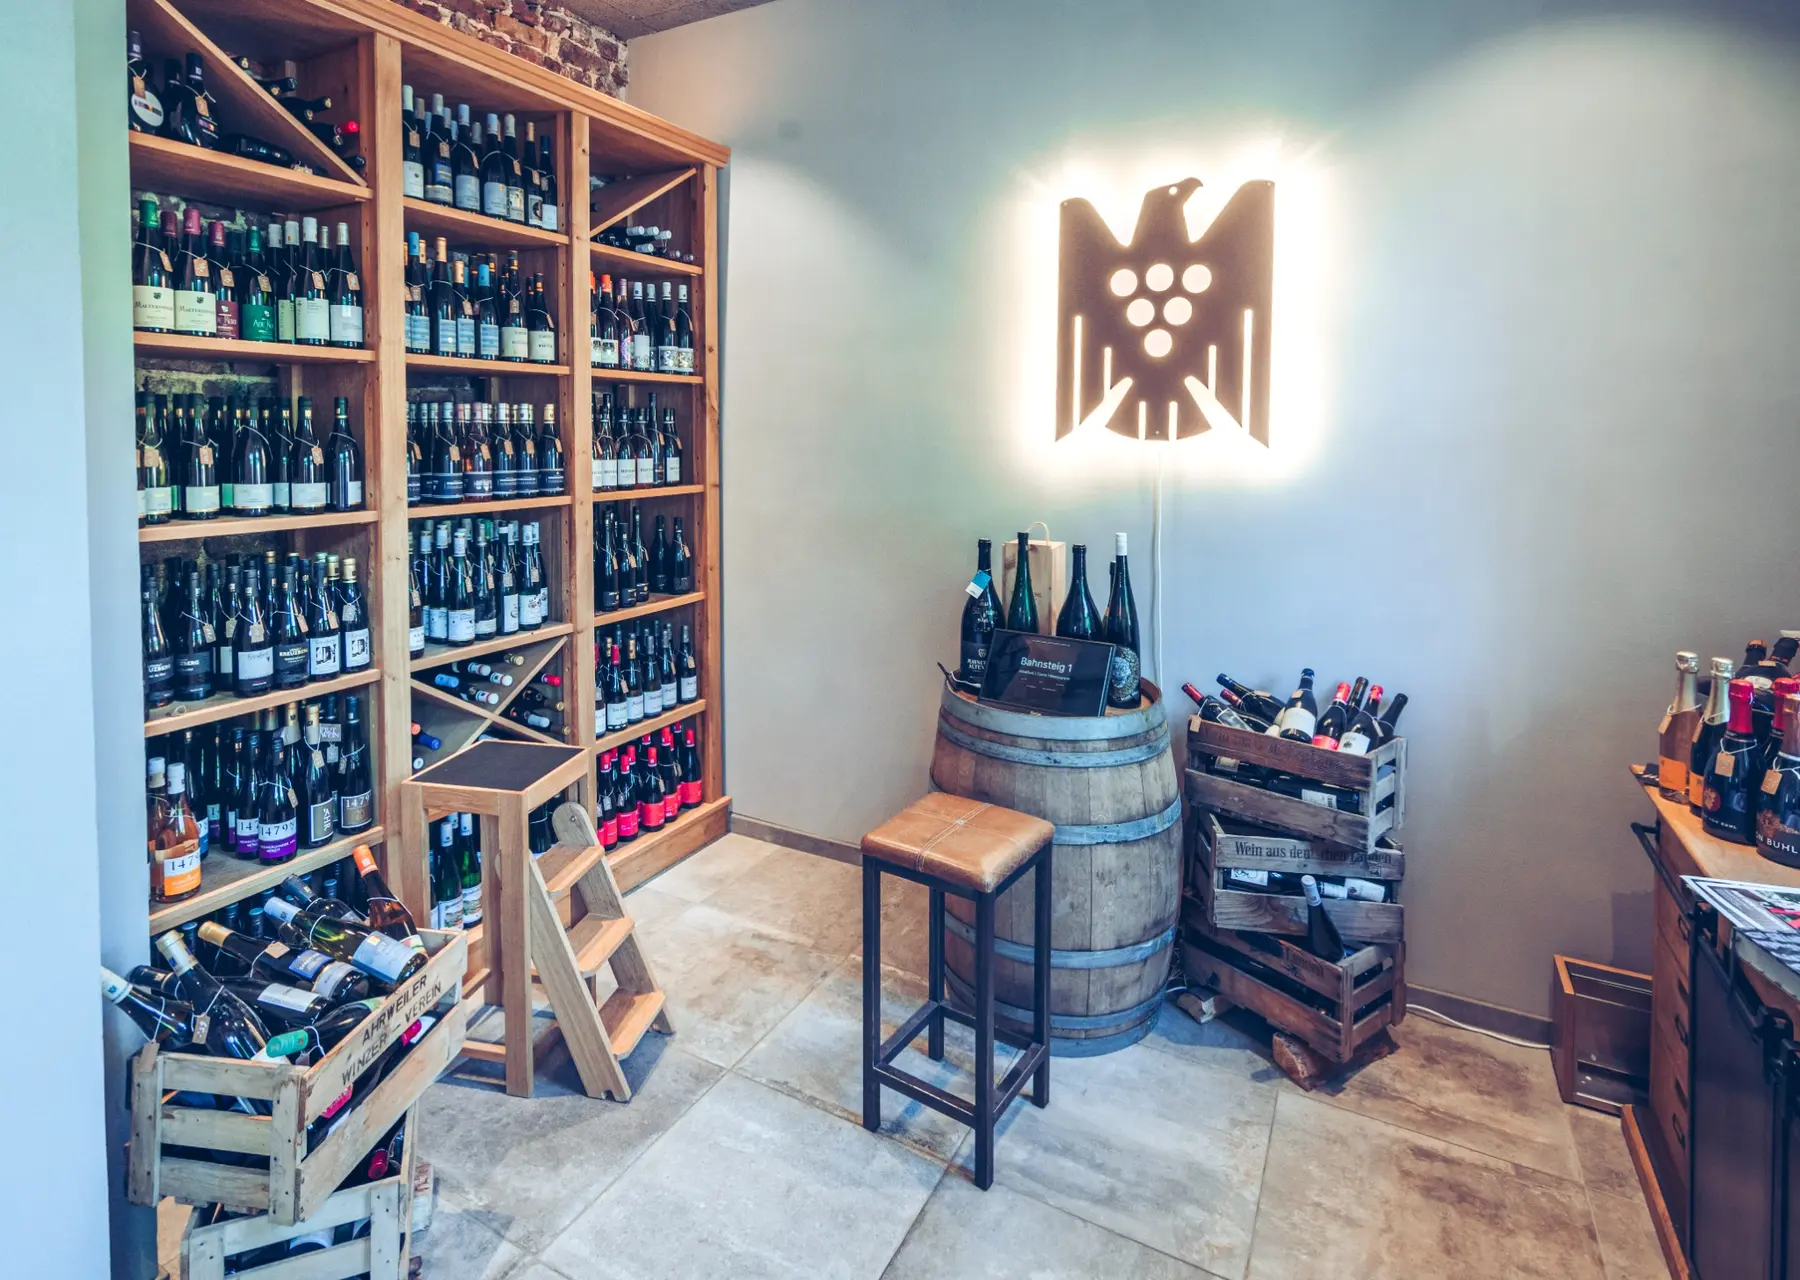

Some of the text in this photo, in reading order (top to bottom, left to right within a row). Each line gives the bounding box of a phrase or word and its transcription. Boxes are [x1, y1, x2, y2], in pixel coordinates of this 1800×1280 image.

[1021, 656, 1073, 673] Bahnsteig 1
[1235, 841, 1262, 857] Wein
[1265, 847, 1286, 858] aus
[1766, 838, 1798, 854] BUHL
[362, 974, 427, 1046] AHRWEILER
[342, 981, 442, 1086] WINZER VEREIN
